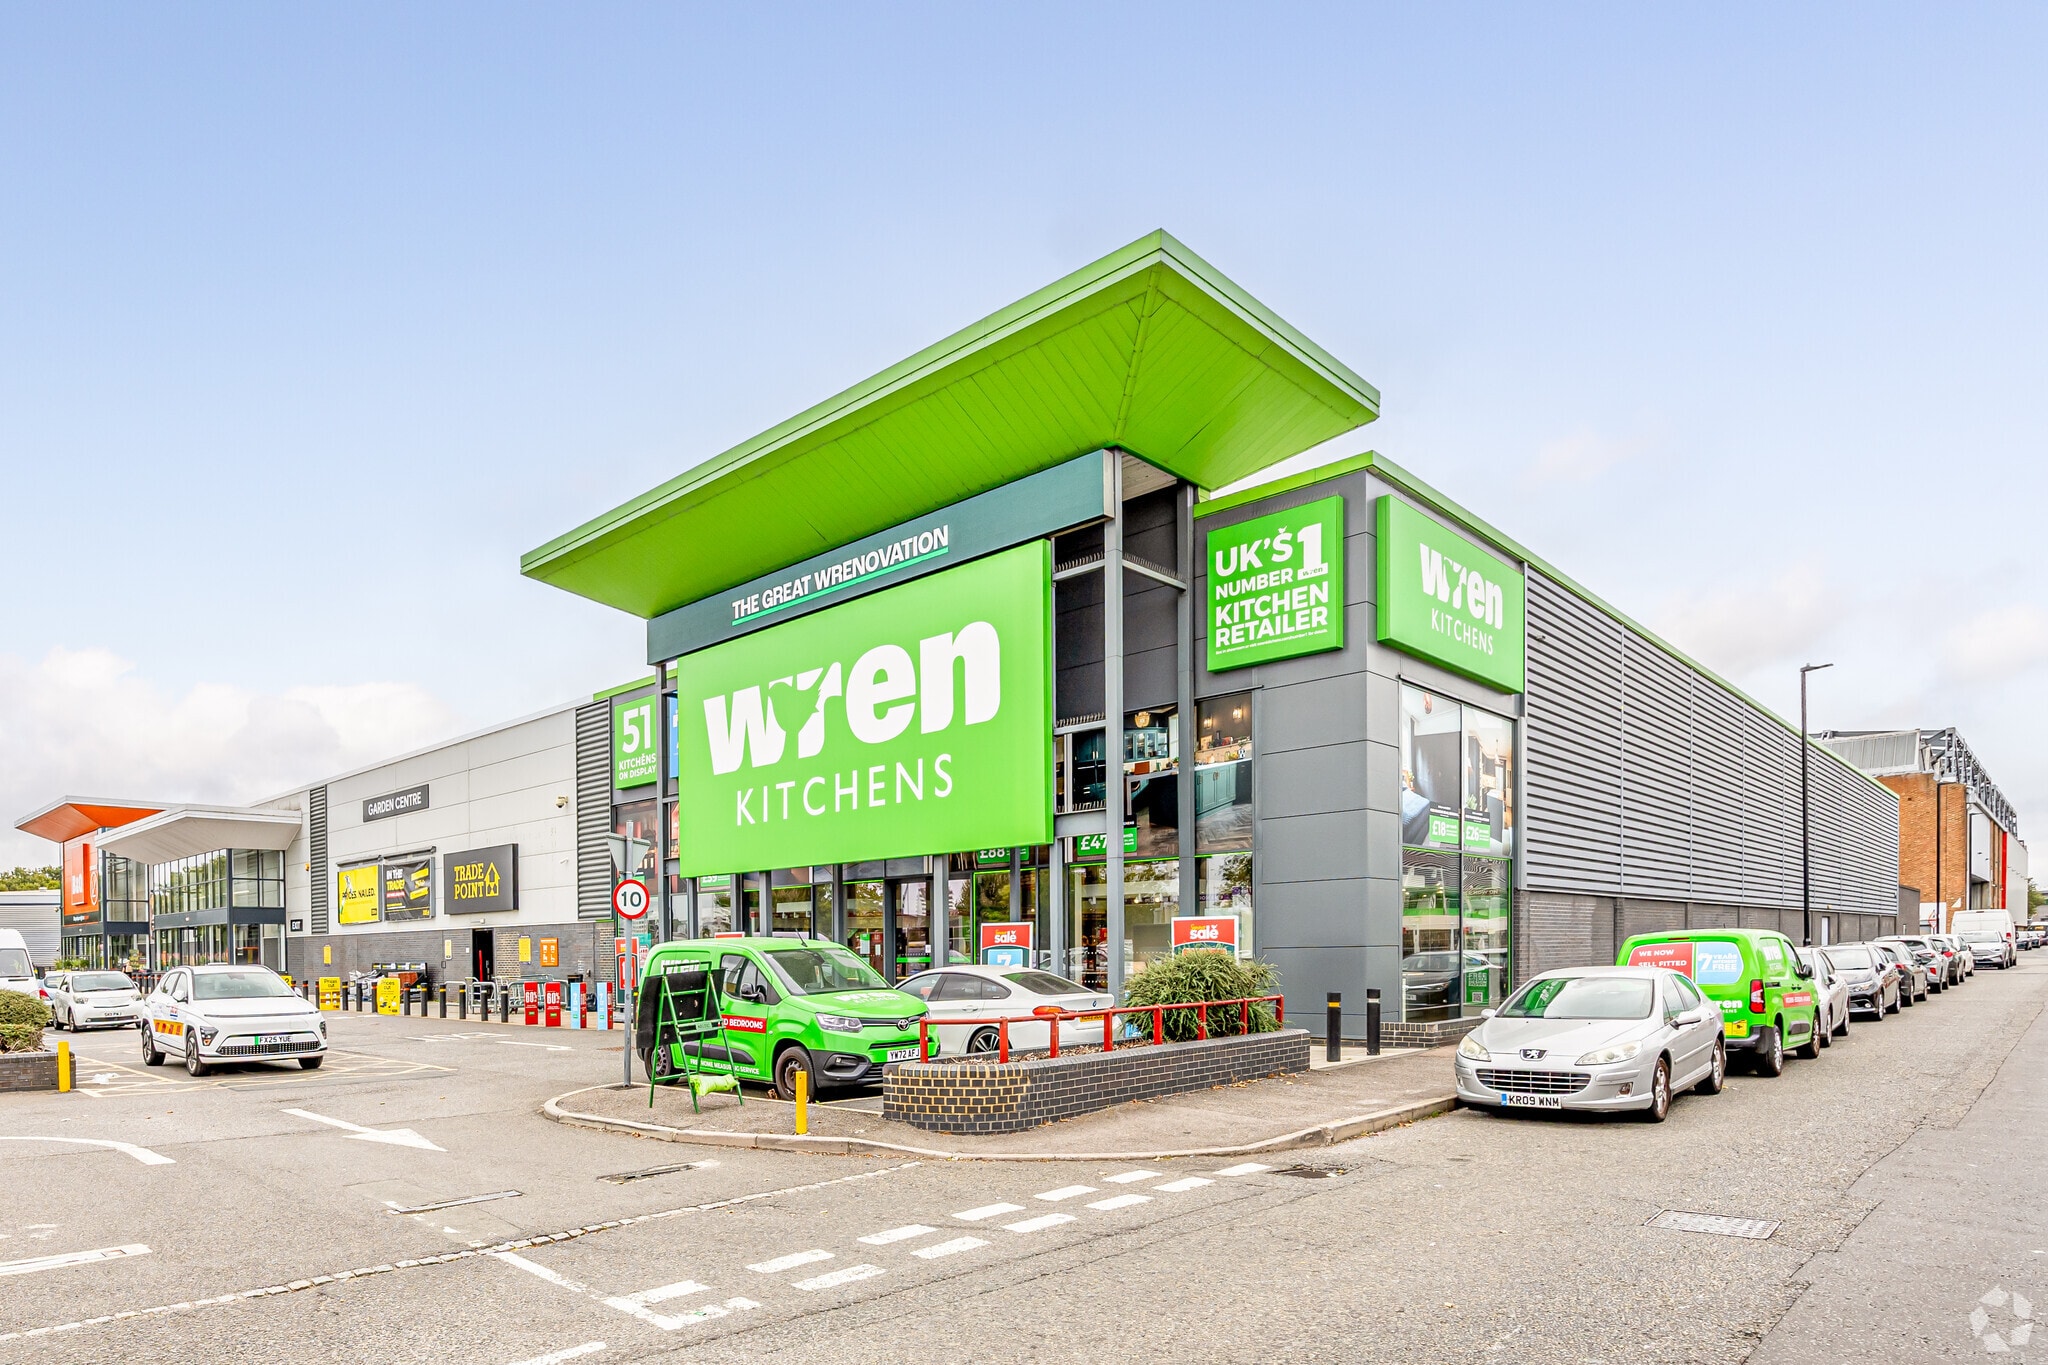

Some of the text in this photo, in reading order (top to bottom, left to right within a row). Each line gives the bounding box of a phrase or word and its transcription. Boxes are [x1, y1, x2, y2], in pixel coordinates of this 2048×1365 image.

[1297, 522, 1328, 580] 1
[732, 524, 949, 620] THE GREAT WRENOVATION
[1302, 567, 1323, 576] wren
[1216, 567, 1293, 600] NUMBER
[1420, 542, 1503, 630] wren
[1216, 581, 1328, 628] KITCHEN
[1216, 606, 1328, 648] RETAILER
[1432, 608, 1494, 656] KITCHENS
[703, 620, 1000, 776] wren
[622, 704, 651, 754] 51
[618, 764, 656, 780] ON DISPLAY
[736, 753, 952, 826] KITCHENS
[368, 792, 422, 816] GARDEN CENTRE
[1466, 825, 1479, 841] £26
[454, 862, 484, 882] TRADE
[454, 881, 484, 899] POINT
[621, 892, 641, 907] 10
[994, 930, 1016, 943] sale
[1190, 924, 1218, 939] sale
[1698, 953, 1712, 970] 7
[730, 1018, 763, 1029] BEDROOMS
[890, 1049, 920, 1060] YW72 AFJ
[740, 1066, 760, 1074] SERVICE
[1509, 1095, 1559, 1106] KR09 WNM
